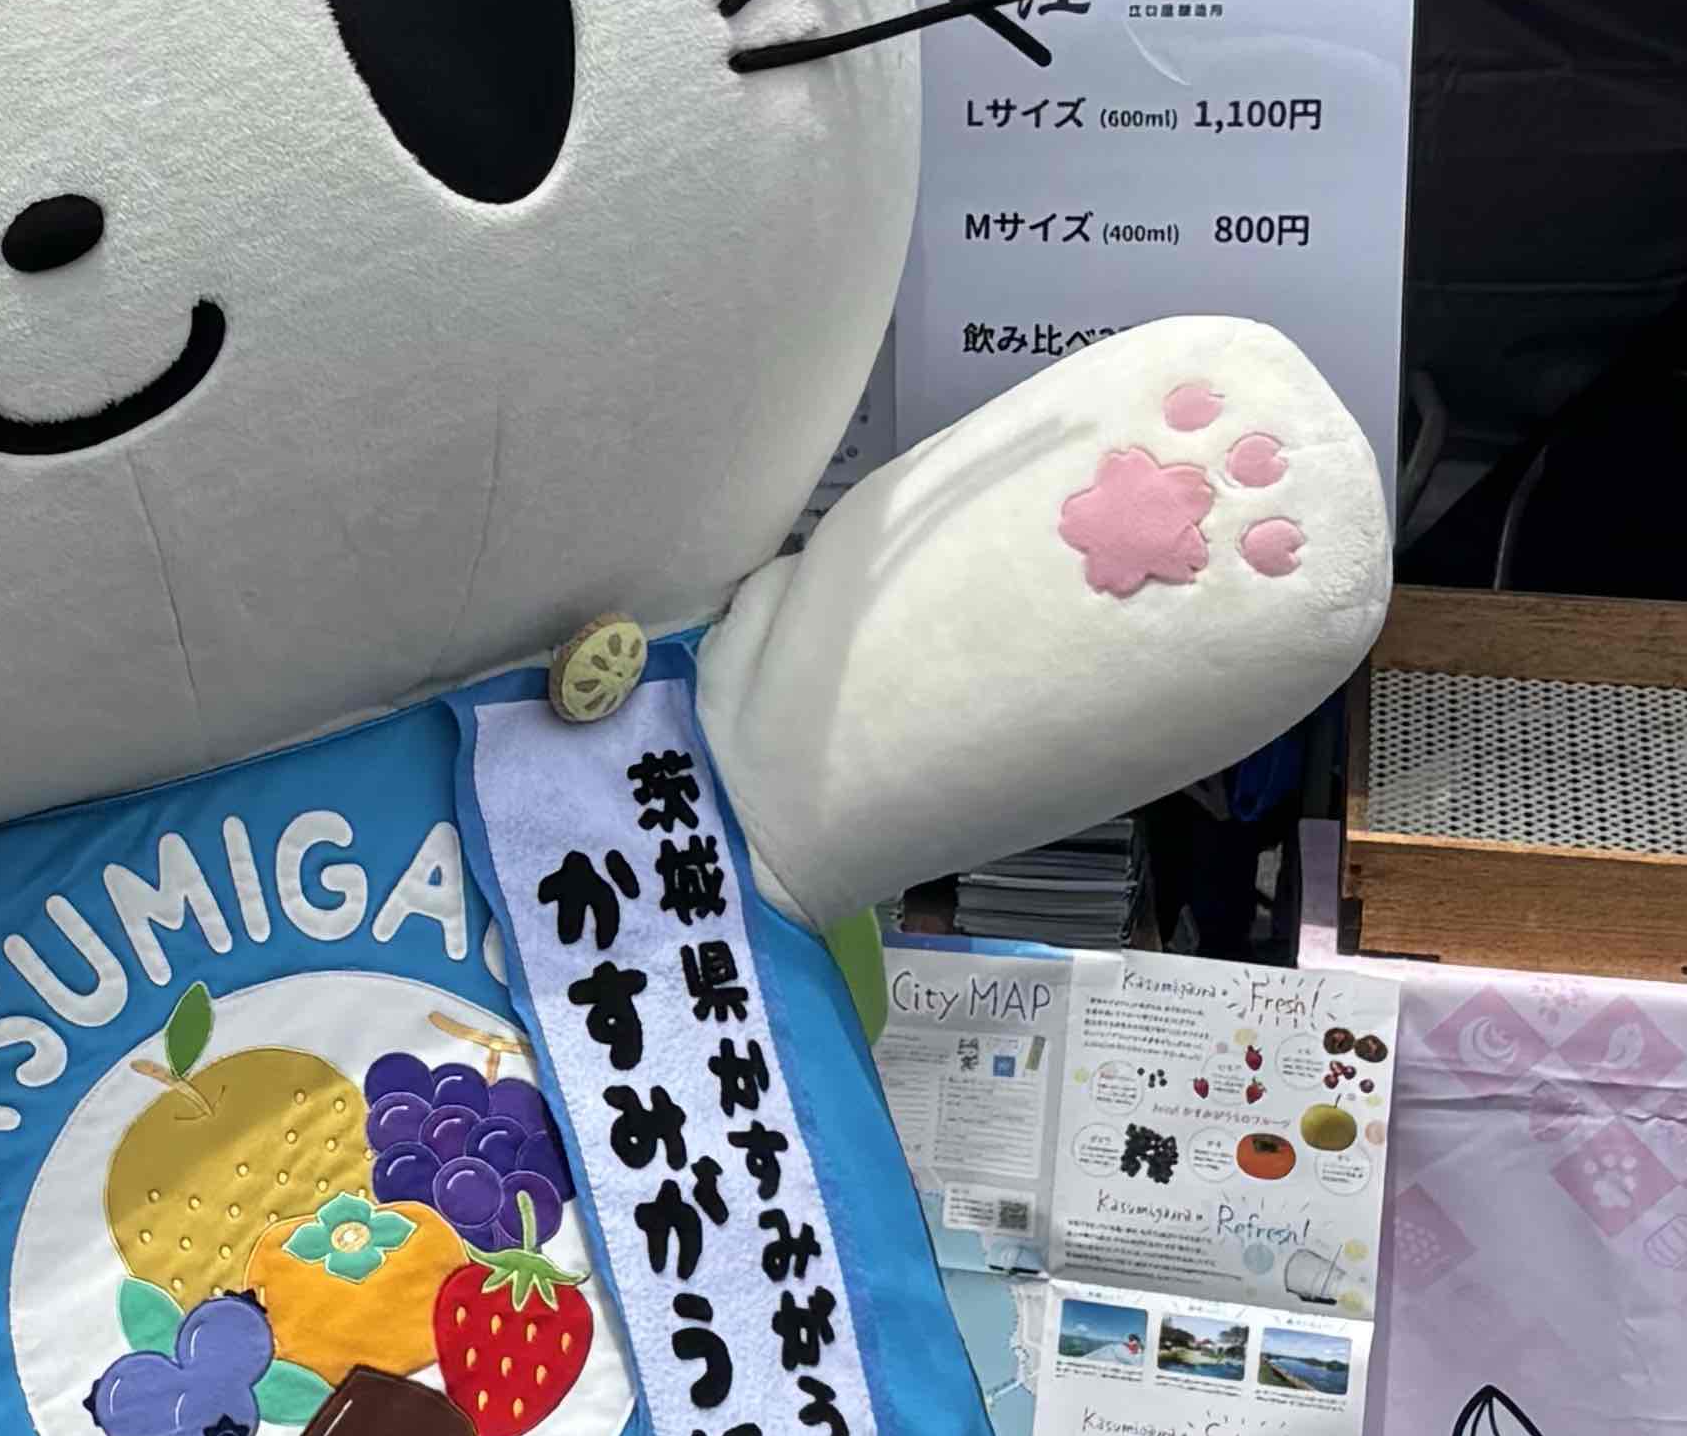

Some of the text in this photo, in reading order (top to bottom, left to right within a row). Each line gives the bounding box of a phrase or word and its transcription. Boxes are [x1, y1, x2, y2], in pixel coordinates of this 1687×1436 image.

[966, 96, 1323, 134] Lサイズ (600ml) 1,100円
[964, 211, 1311, 247] Mサイズ (400ml) 800円
[962, 322, 1122, 356] 飲み比べ
[892, 970, 1051, 1022] City MAP
[1216, 1203, 1311, 1245] Refresh!
